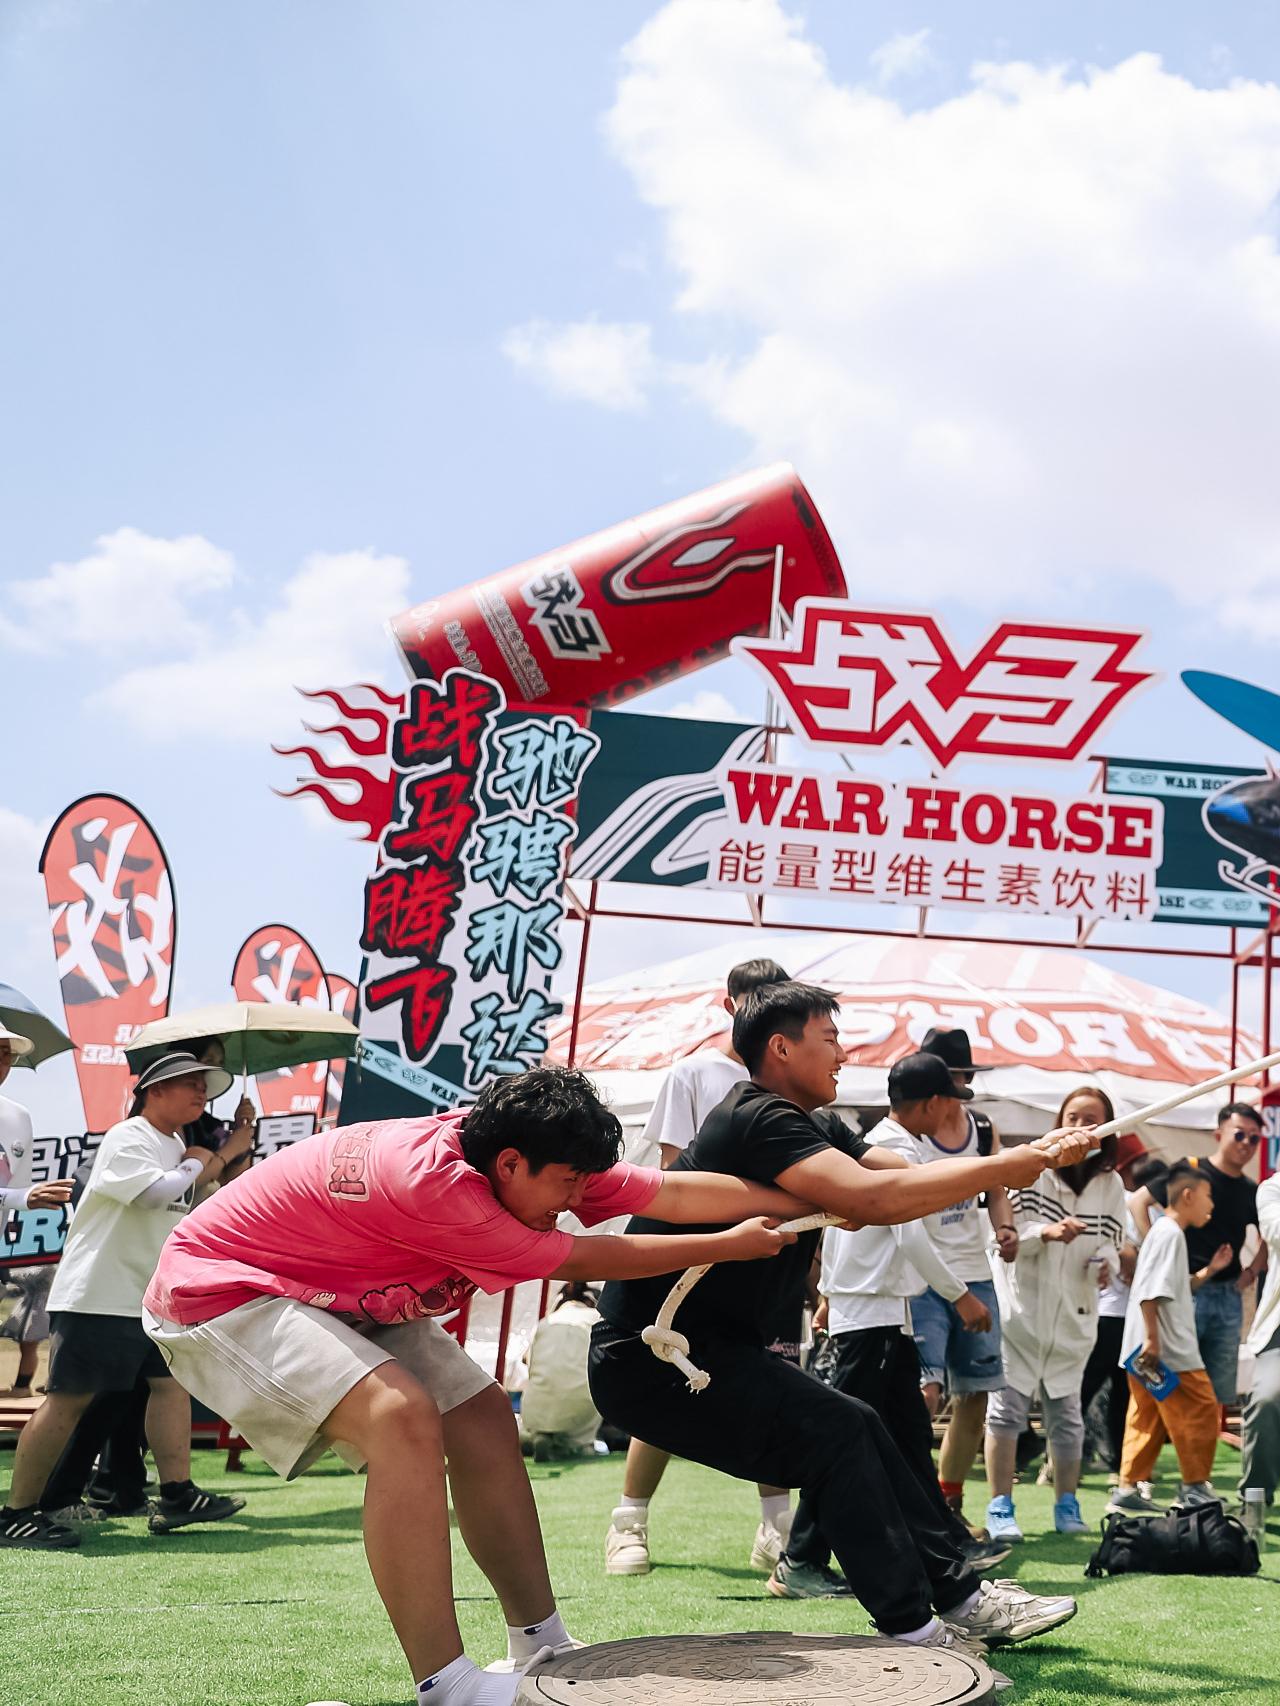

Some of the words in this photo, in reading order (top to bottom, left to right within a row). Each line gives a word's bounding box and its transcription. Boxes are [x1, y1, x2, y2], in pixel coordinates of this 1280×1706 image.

[762, 612, 1137, 757] 战马
[727, 770, 888, 837] WAR
[903, 786, 1154, 859] HORSE
[1164, 774, 1197, 790] WAR
[366, 678, 496, 1052] 战马腾飞
[717, 838, 1152, 916] 能量型维生素饮料
